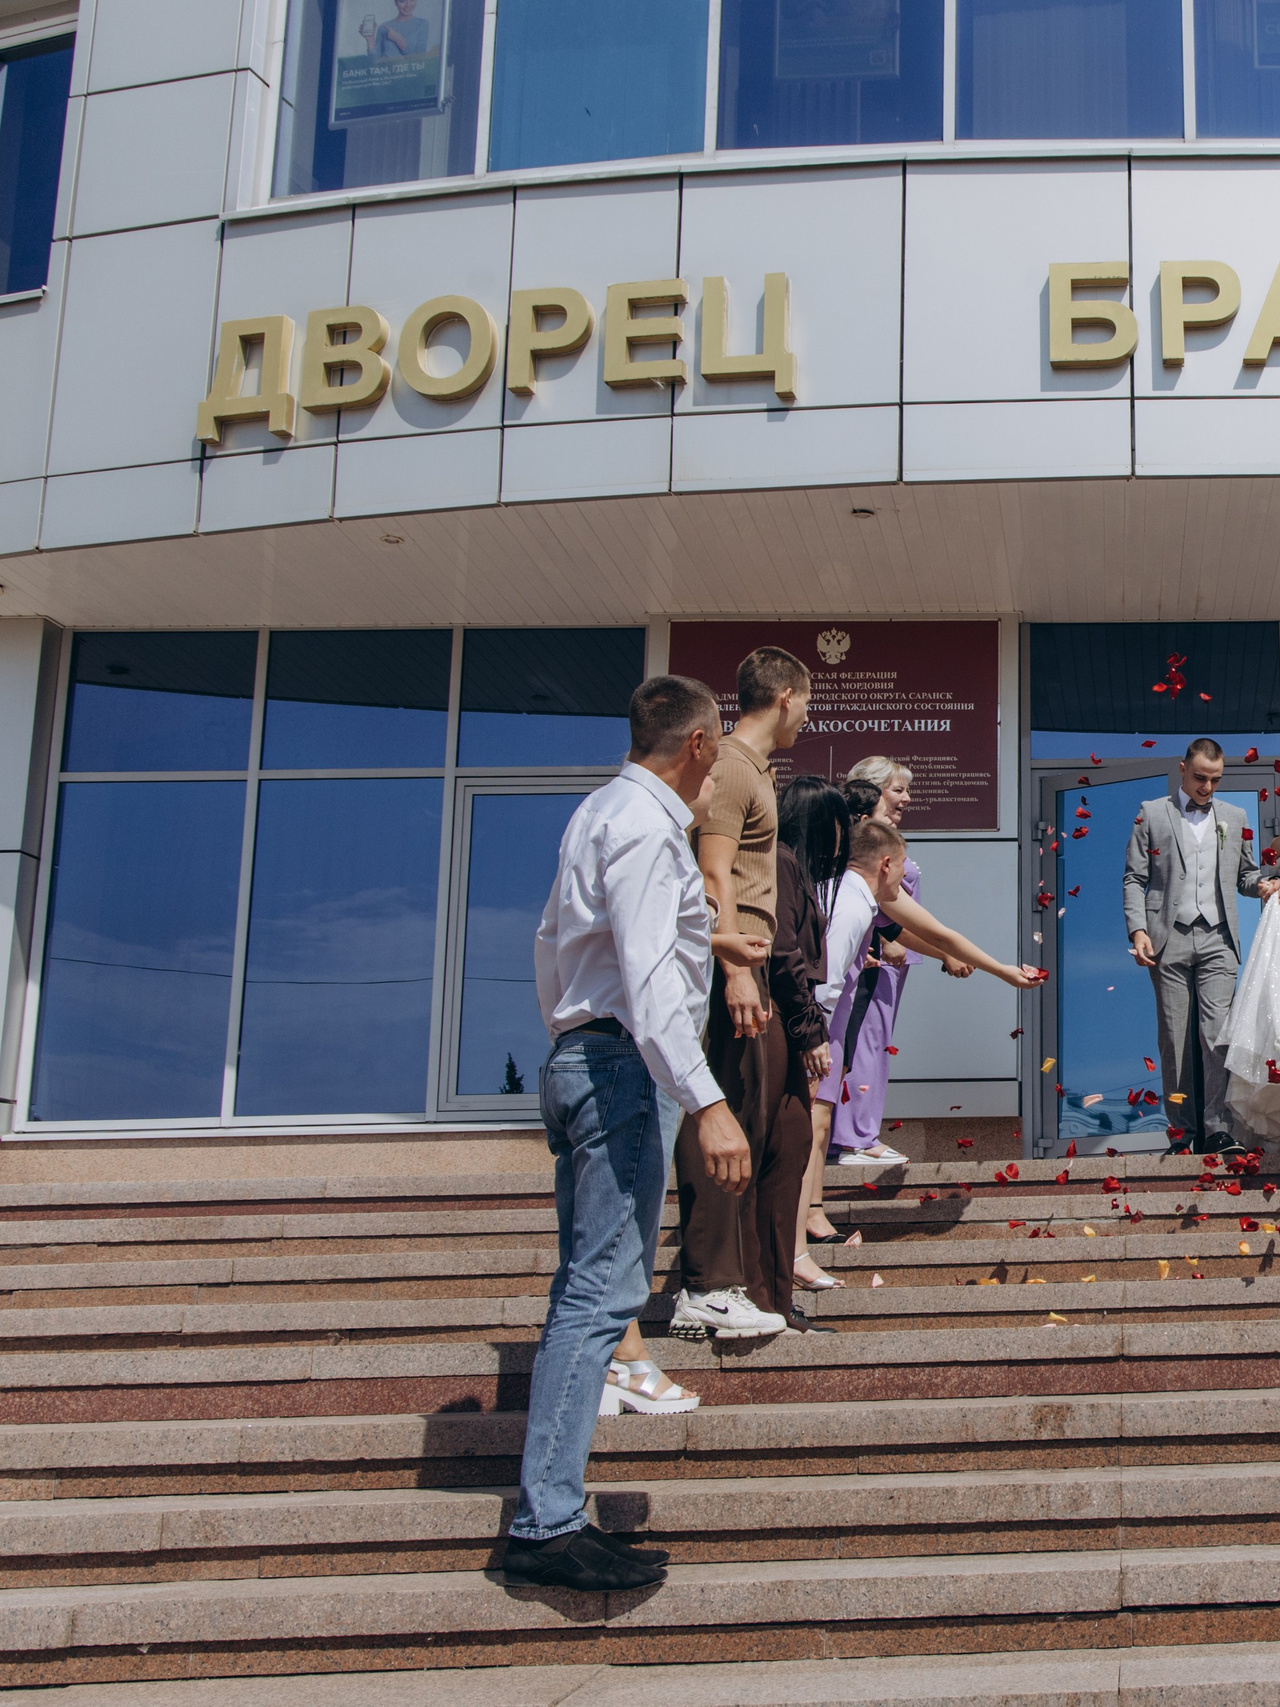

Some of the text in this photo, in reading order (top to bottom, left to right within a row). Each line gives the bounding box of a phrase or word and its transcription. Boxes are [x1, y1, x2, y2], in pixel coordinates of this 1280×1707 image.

[342, 62, 425, 78] БАНК ТАМ, ГДЕ ТЫ
[195, 272, 798, 445] ДВОРЕЦ
[839, 671, 897, 680] ФЕДЕРАЦИЯ
[841, 682, 894, 690] МОРДОВИЯ
[810, 692, 953, 702] ОРОДСКОГО ОКРУГА САРАНСК
[806, 702, 975, 711] КТОВ ГРАЖДАНСКОГО СОСТОЯНИЯ
[798, 719, 951, 733] АКОСОЧЕТАНИЯ
[908, 788, 949, 796] равлениясь
